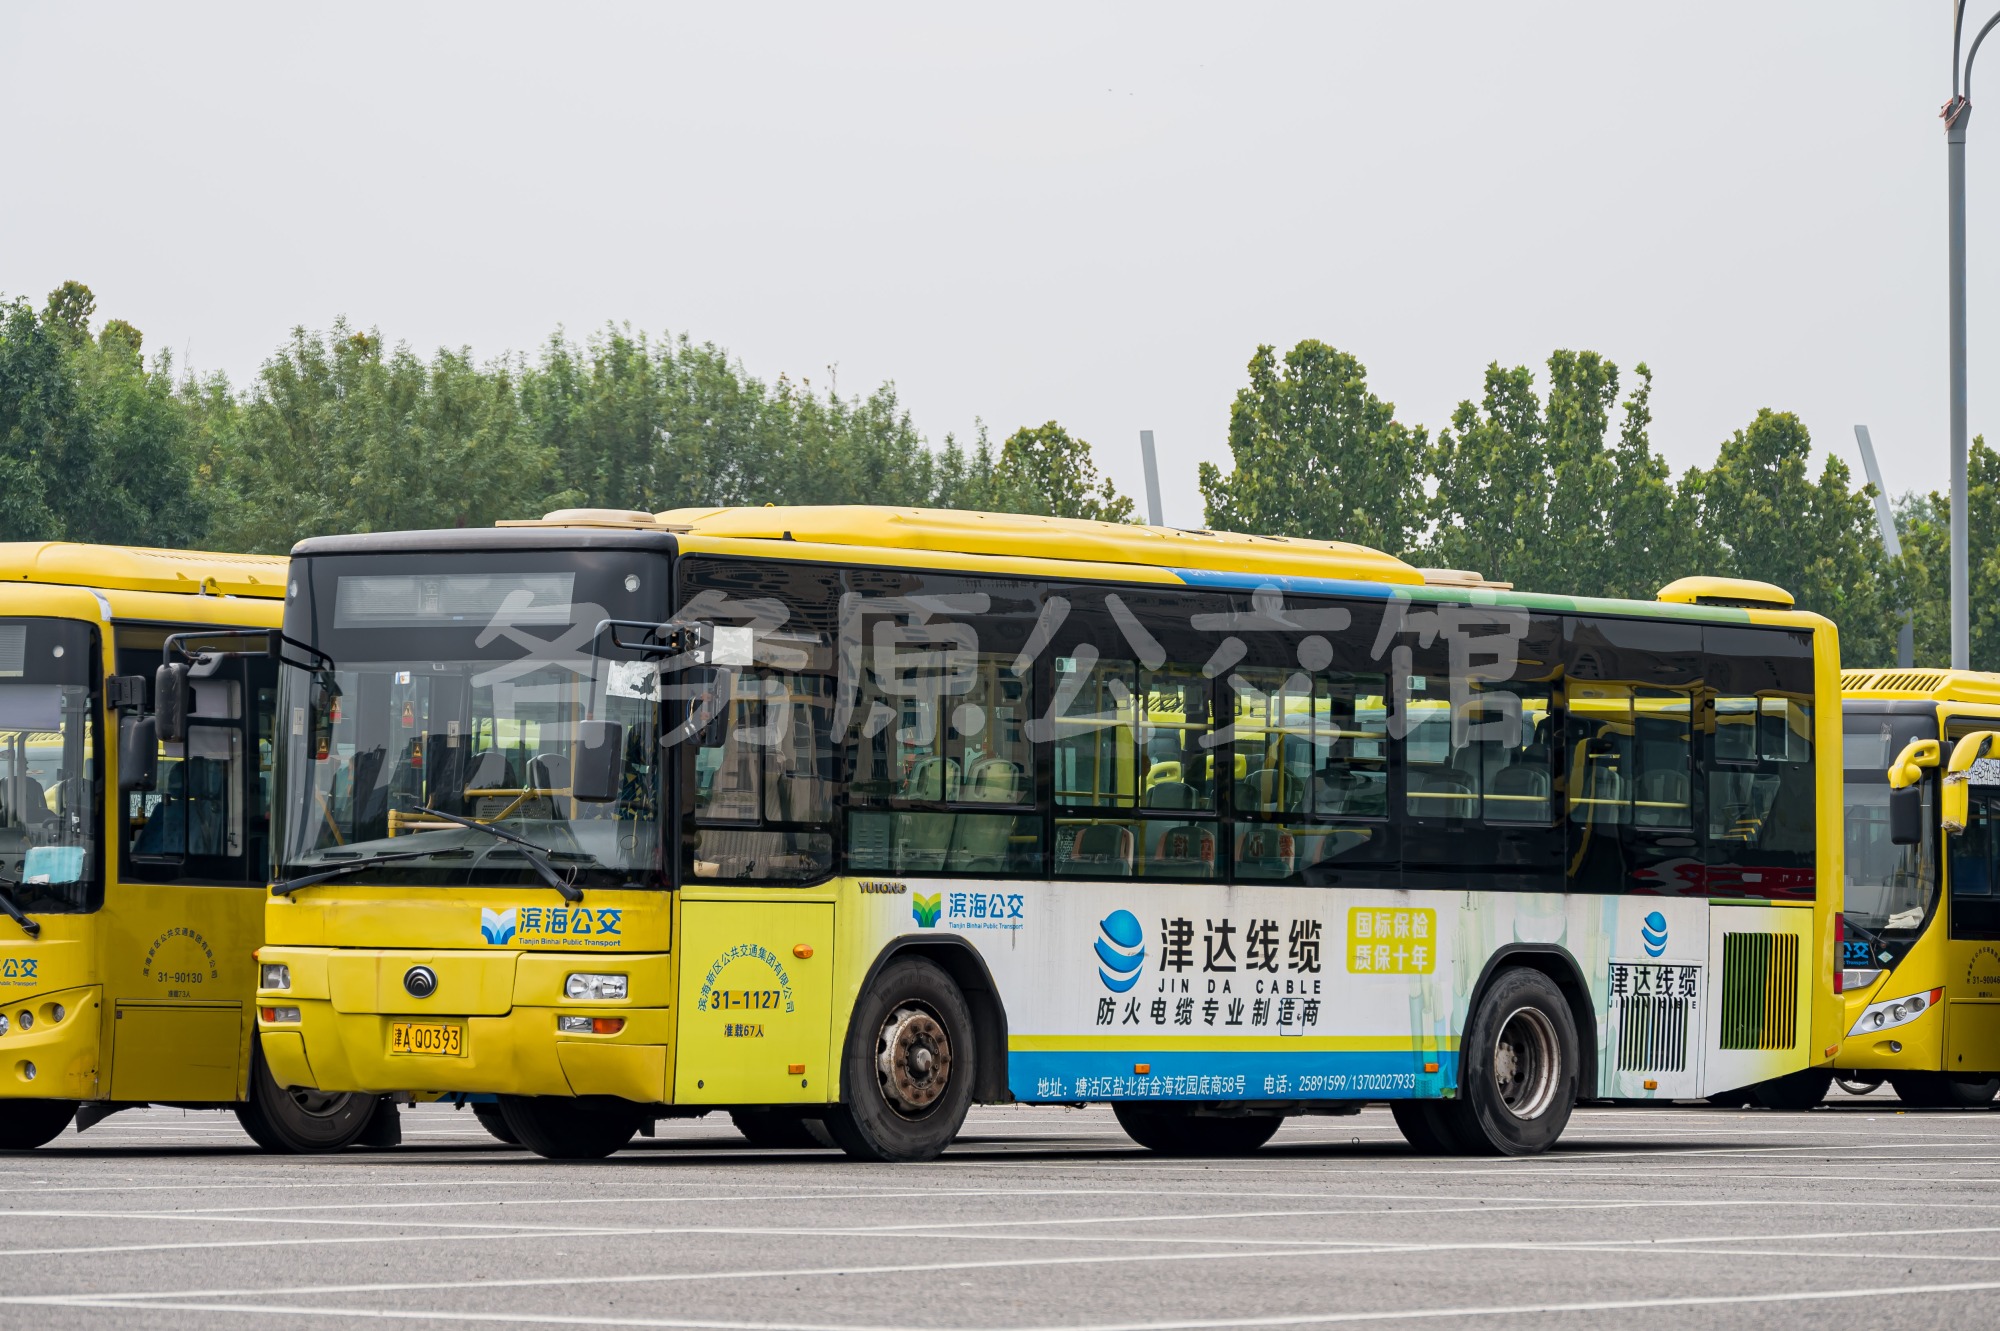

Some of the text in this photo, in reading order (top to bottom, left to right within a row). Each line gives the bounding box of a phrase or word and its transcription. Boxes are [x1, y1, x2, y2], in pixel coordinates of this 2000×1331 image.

[858, 881, 907, 894] YUTONG
[949, 892, 1024, 919] 滨海公交
[519, 907, 622, 935] 滨海公交
[949, 922, 966, 930] Tianjin
[983, 922, 998, 930] Public
[999, 922, 1024, 931] Transport
[518, 937, 540, 946] Tianjin
[562, 938, 583, 946] Public
[584, 939, 621, 947] Transport
[1159, 917, 1322, 974] 津达线缆
[1355, 944, 1428, 972] 质保十年
[158, 971, 203, 984] 31-90130
[698, 943, 795, 1013] 滨海新区公共交通集团有限公司
[1158, 978, 1322, 995] JIN DA CABLE
[1609, 965, 1697, 998] 津达线缆
[711, 990, 781, 1010] 31-1127
[1096, 996, 1322, 1026] 防火电缆专业制造商
[724, 1023, 764, 1038] 准载67人
